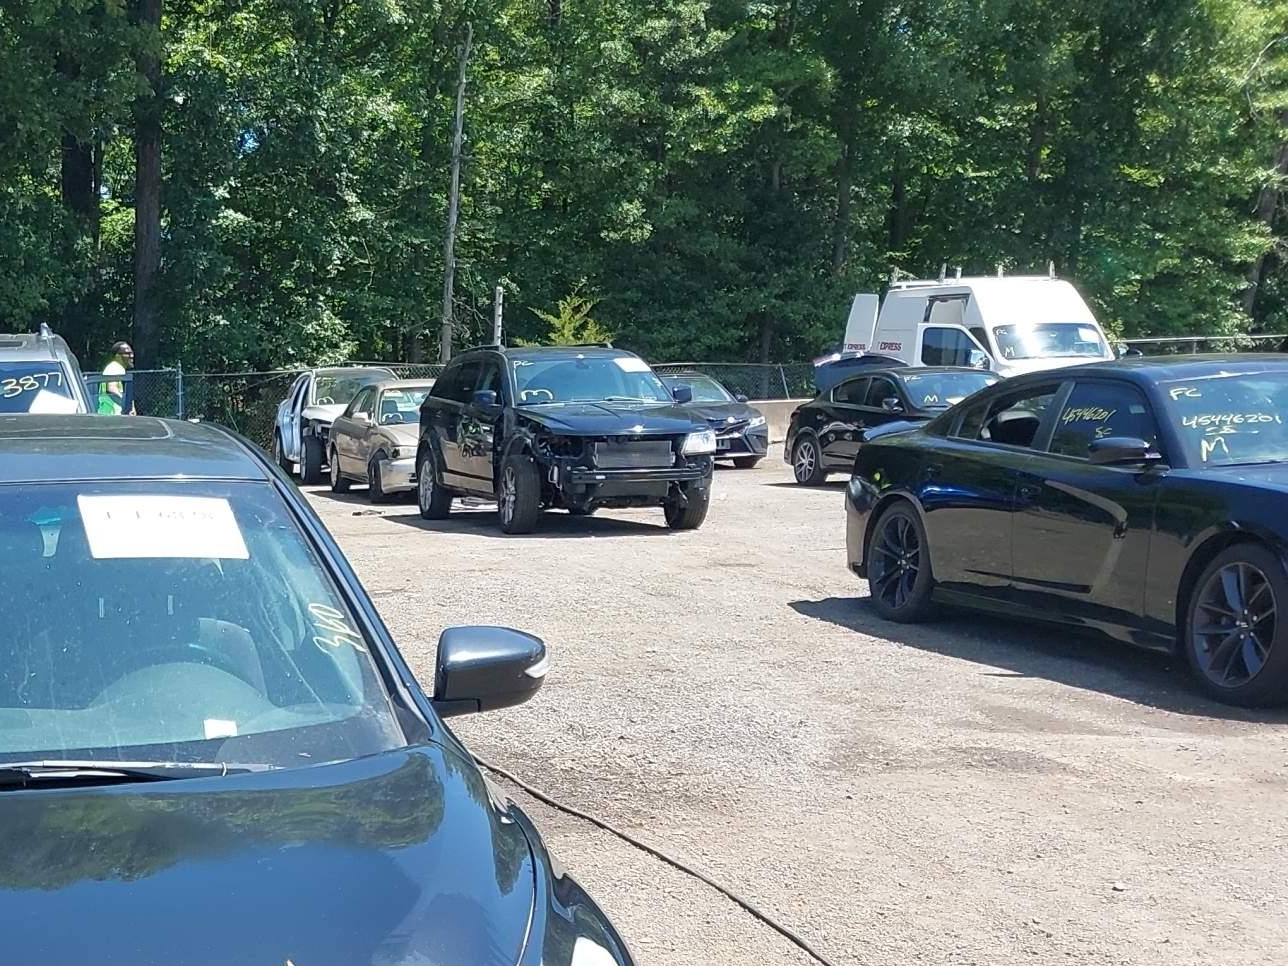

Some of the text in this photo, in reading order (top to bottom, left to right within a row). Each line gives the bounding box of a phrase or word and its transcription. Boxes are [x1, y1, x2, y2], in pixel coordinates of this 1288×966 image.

[1, 371, 62, 398] 3877
[923, 394, 939, 403] M
[1169, 387, 1203, 401] FC
[1062, 407, 1118, 426] 45446201
[1181, 412, 1283, 430] 45446201
[1200, 437, 1230, 462] M
